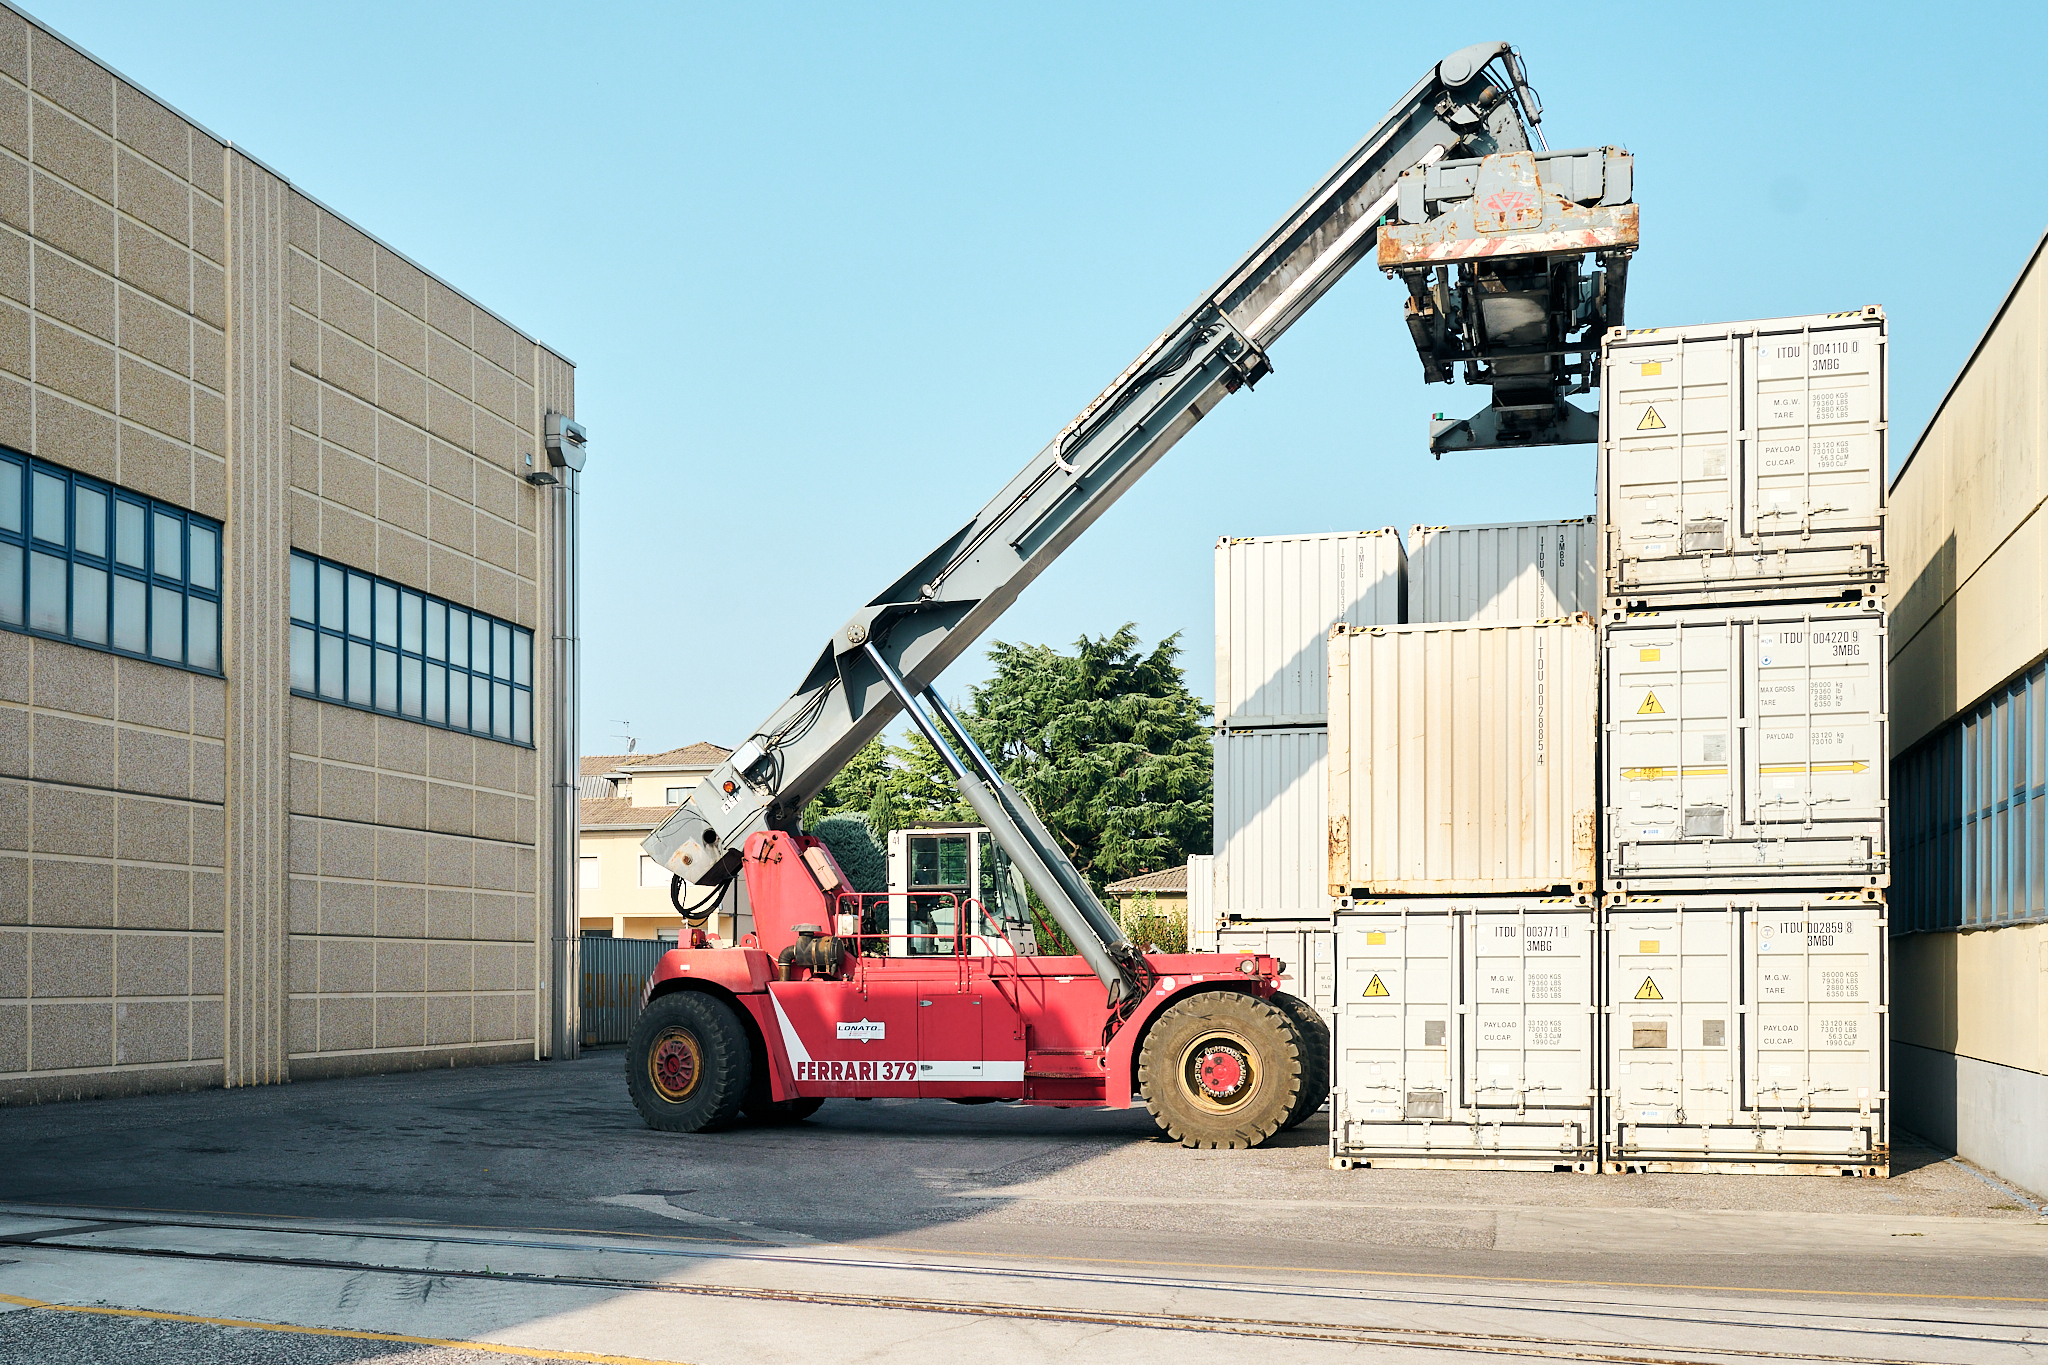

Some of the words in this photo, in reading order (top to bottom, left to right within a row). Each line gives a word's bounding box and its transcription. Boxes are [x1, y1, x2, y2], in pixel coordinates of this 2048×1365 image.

[1777, 346, 1800, 358] ITDU
[1813, 342, 1848, 355] 004110
[1851, 340, 1859, 354] 0
[1812, 359, 1839, 371] 3MBG
[1765, 445, 1800, 454] PAYLOAD
[1779, 632, 1803, 644] ITDU
[1813, 631, 1849, 644] 004220
[1851, 630, 1858, 643] 9
[1833, 645, 1860, 656] 3MBG
[1495, 927, 1516, 937] ITDU
[1526, 927, 1558, 937] 003771
[1780, 922, 1803, 933] ITDU
[1846, 922, 1853, 934] 8
[1526, 941, 1552, 951] 3MBG
[798, 1061, 877, 1080] FERRARI
[882, 1062, 917, 1080] 379
